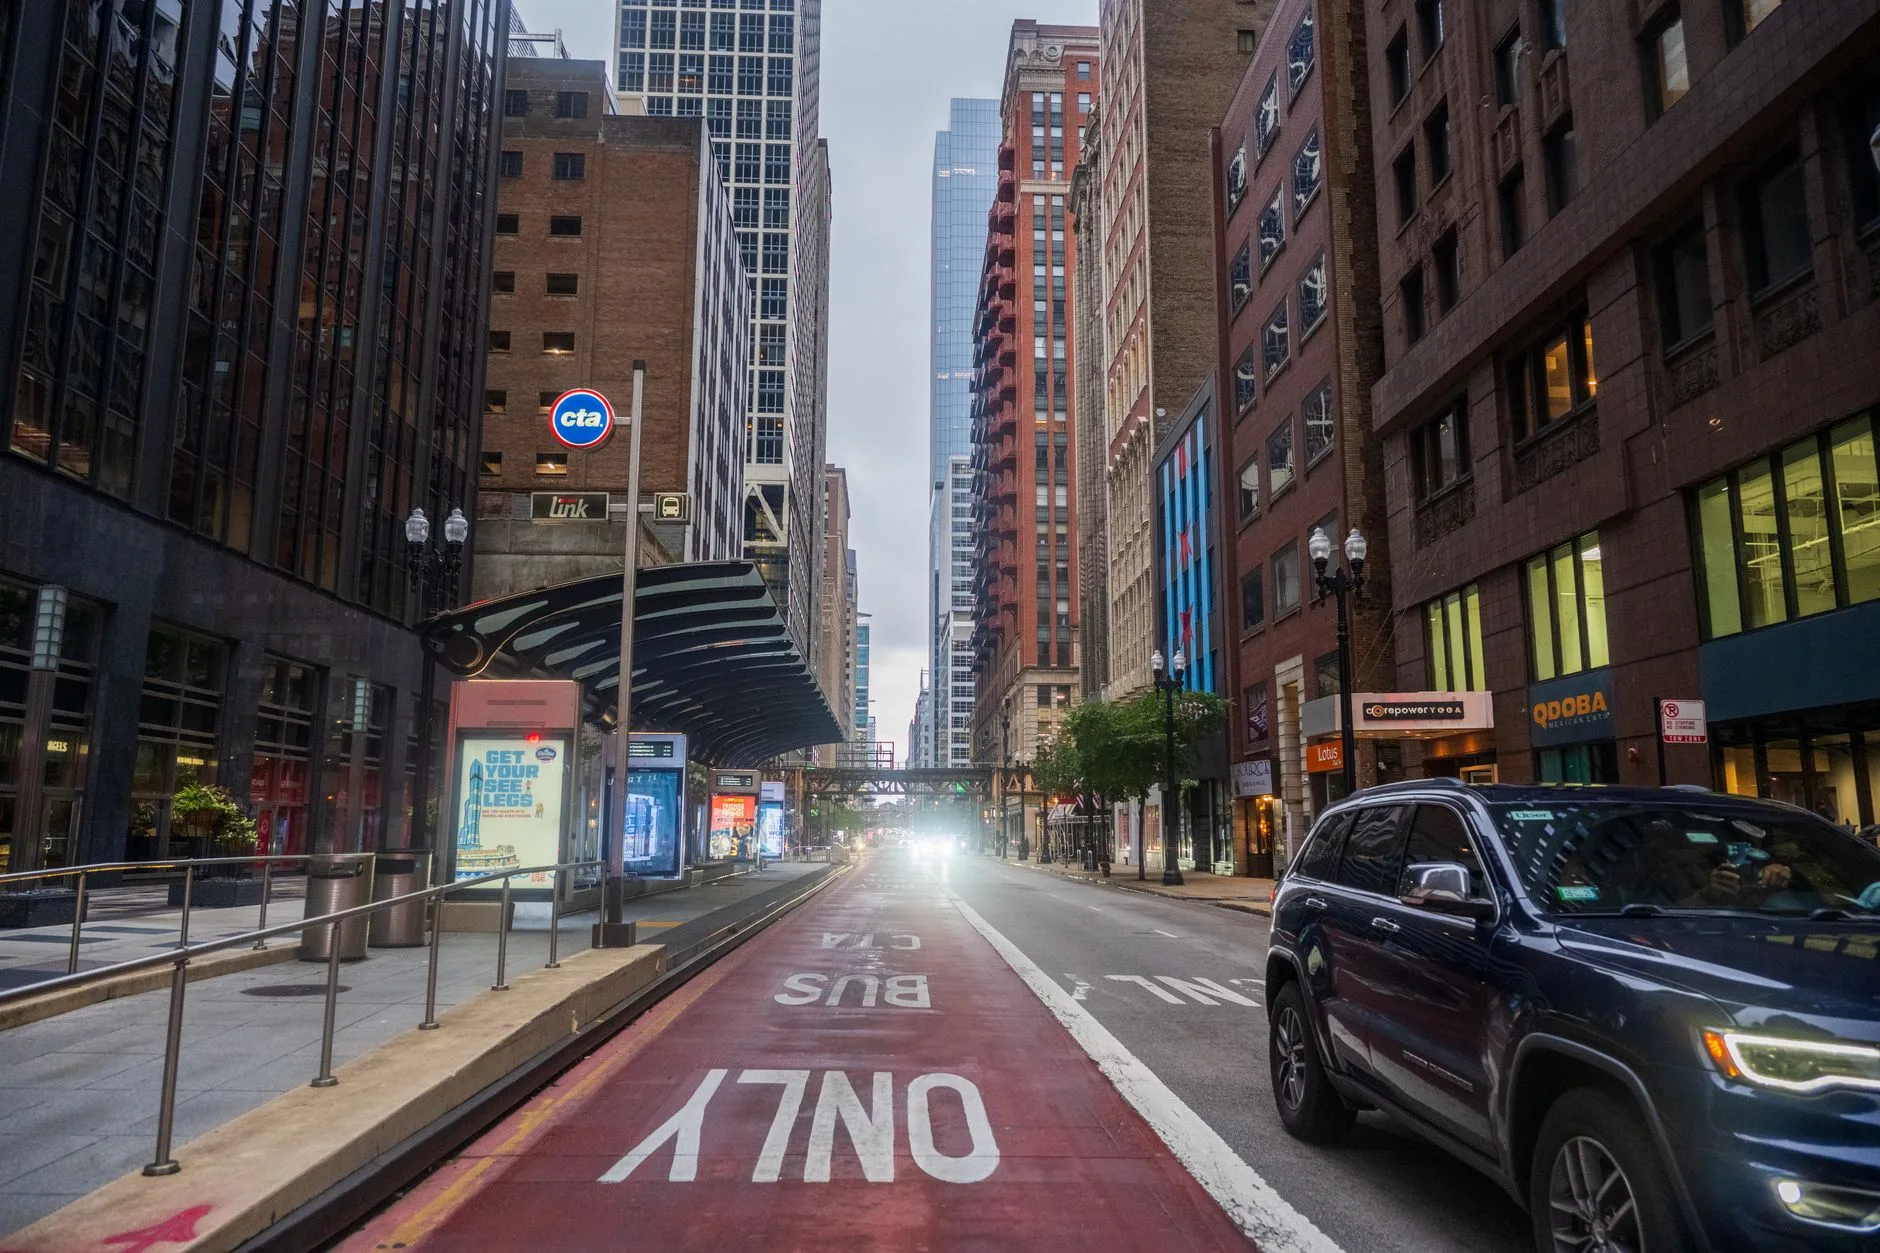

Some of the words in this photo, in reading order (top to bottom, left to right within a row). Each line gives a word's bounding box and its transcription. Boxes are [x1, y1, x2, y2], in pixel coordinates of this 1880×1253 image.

[1429, 706, 1463, 714] YOGA
[1533, 691, 1608, 730] QDOBA
[485, 750, 526, 764] GET
[1317, 746, 1338, 761] Lotus
[484, 765, 539, 779] YOUR
[484, 779, 522, 793] SEE
[483, 794, 533, 807] LEGS
[1515, 811, 1549, 819] Uber
[774, 972, 932, 1009] BUS
[596, 1068, 1001, 1185] ONLY
